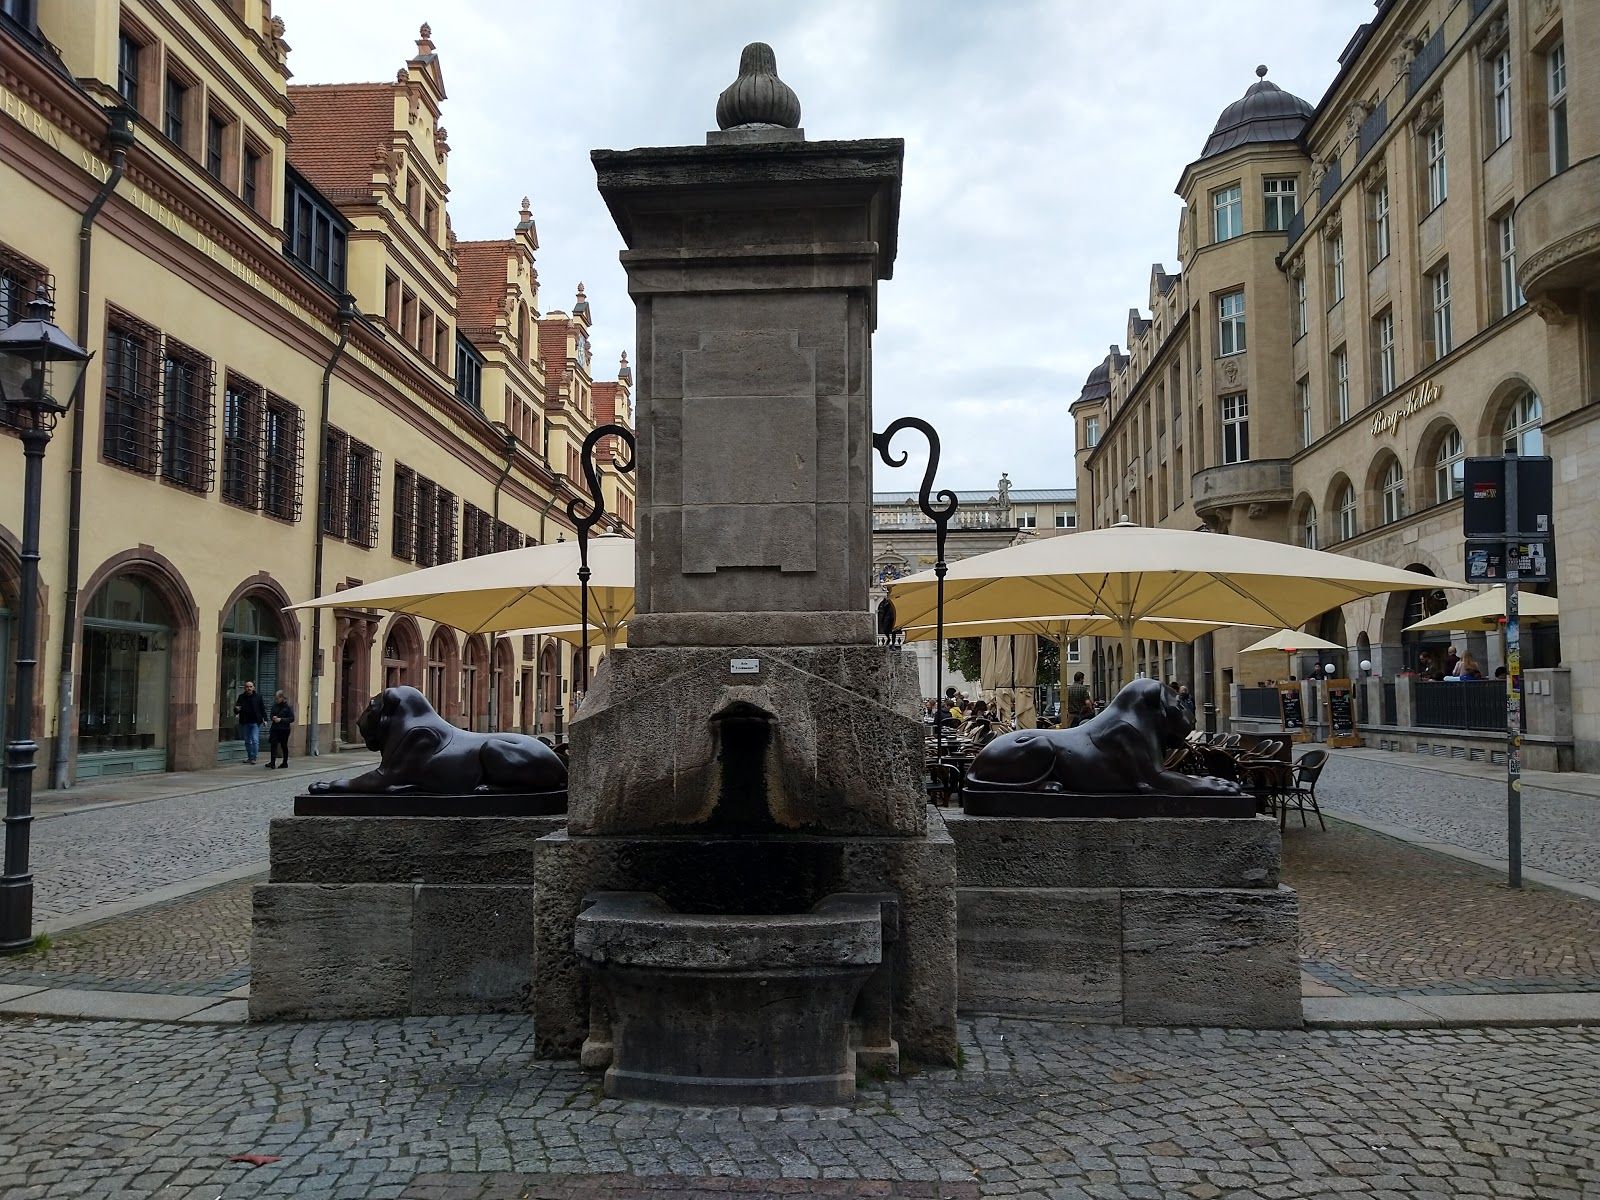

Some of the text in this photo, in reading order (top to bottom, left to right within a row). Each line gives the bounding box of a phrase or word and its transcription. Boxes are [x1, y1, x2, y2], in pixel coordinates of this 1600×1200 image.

[0, 86, 62, 151] ERRN
[82, 151, 112, 184] SEY
[129, 187, 183, 235] ALLEIN
[197, 232, 218, 260] DIE
[231, 257, 261, 289] EHRE
[1370, 380, 1443, 436] Burg-Keller
